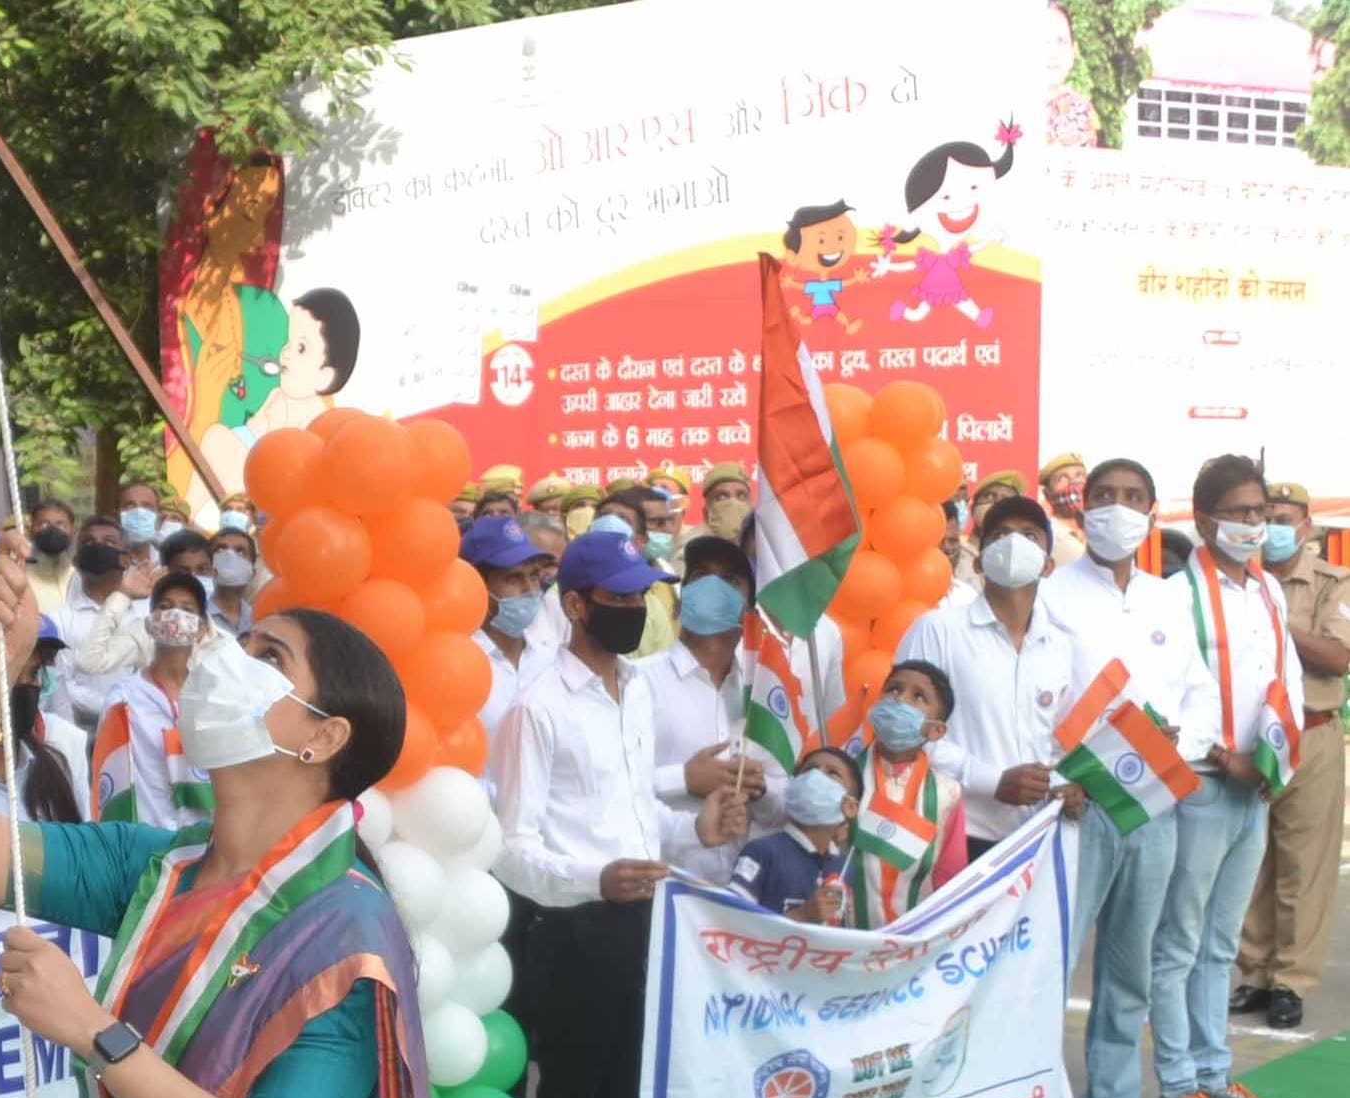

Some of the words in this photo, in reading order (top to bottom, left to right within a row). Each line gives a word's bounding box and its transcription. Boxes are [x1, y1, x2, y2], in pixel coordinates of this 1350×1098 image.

[500, 363, 522, 389] 14
[559, 362, 590, 383] दस्त
[595, 356, 611, 381] के
[690, 355, 723, 377] दस्त
[728, 349, 746, 374] के
[602, 423, 619, 449] के
[625, 425, 639, 449] 6
[681, 425, 710, 446] तक
